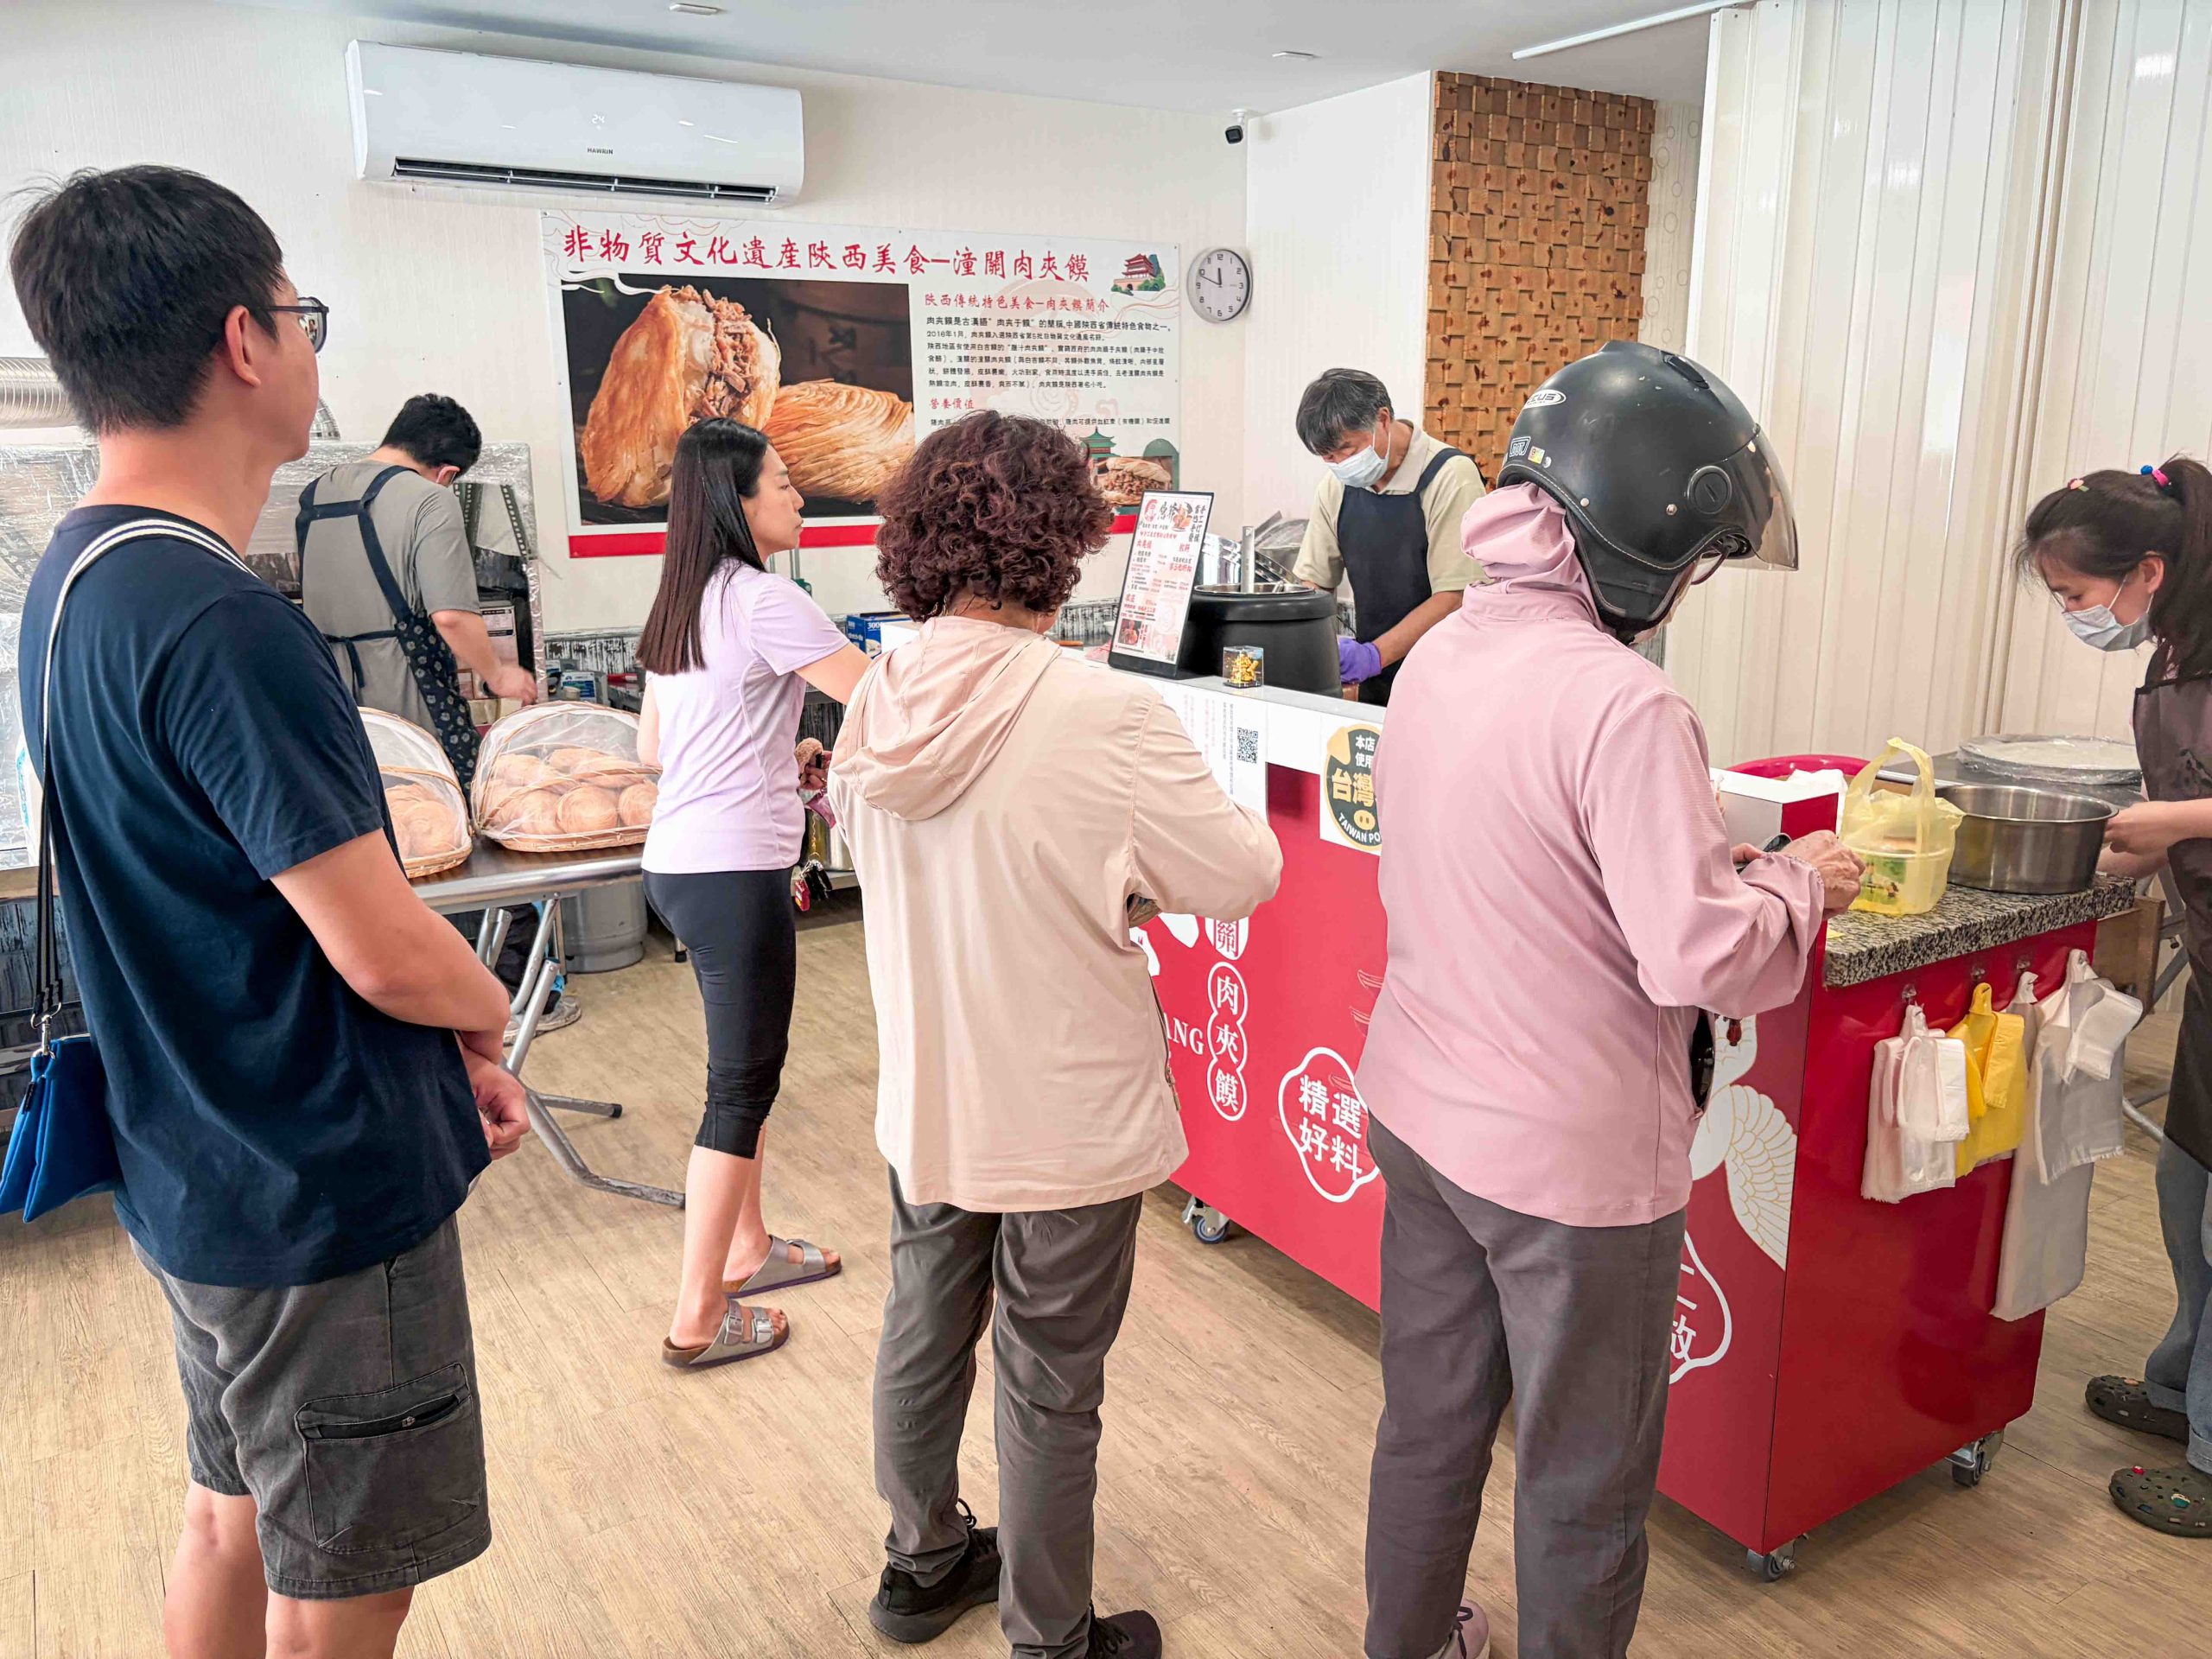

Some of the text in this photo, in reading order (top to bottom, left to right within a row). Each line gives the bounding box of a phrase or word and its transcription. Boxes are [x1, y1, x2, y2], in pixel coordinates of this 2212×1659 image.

[1355, 734, 1375, 751] 本店
[1355, 753, 1374, 768] 使用
[1338, 812, 1367, 842] TAIWAN
[1298, 1074, 1362, 1140] 精選
[1298, 1116, 1363, 1181] 好料
